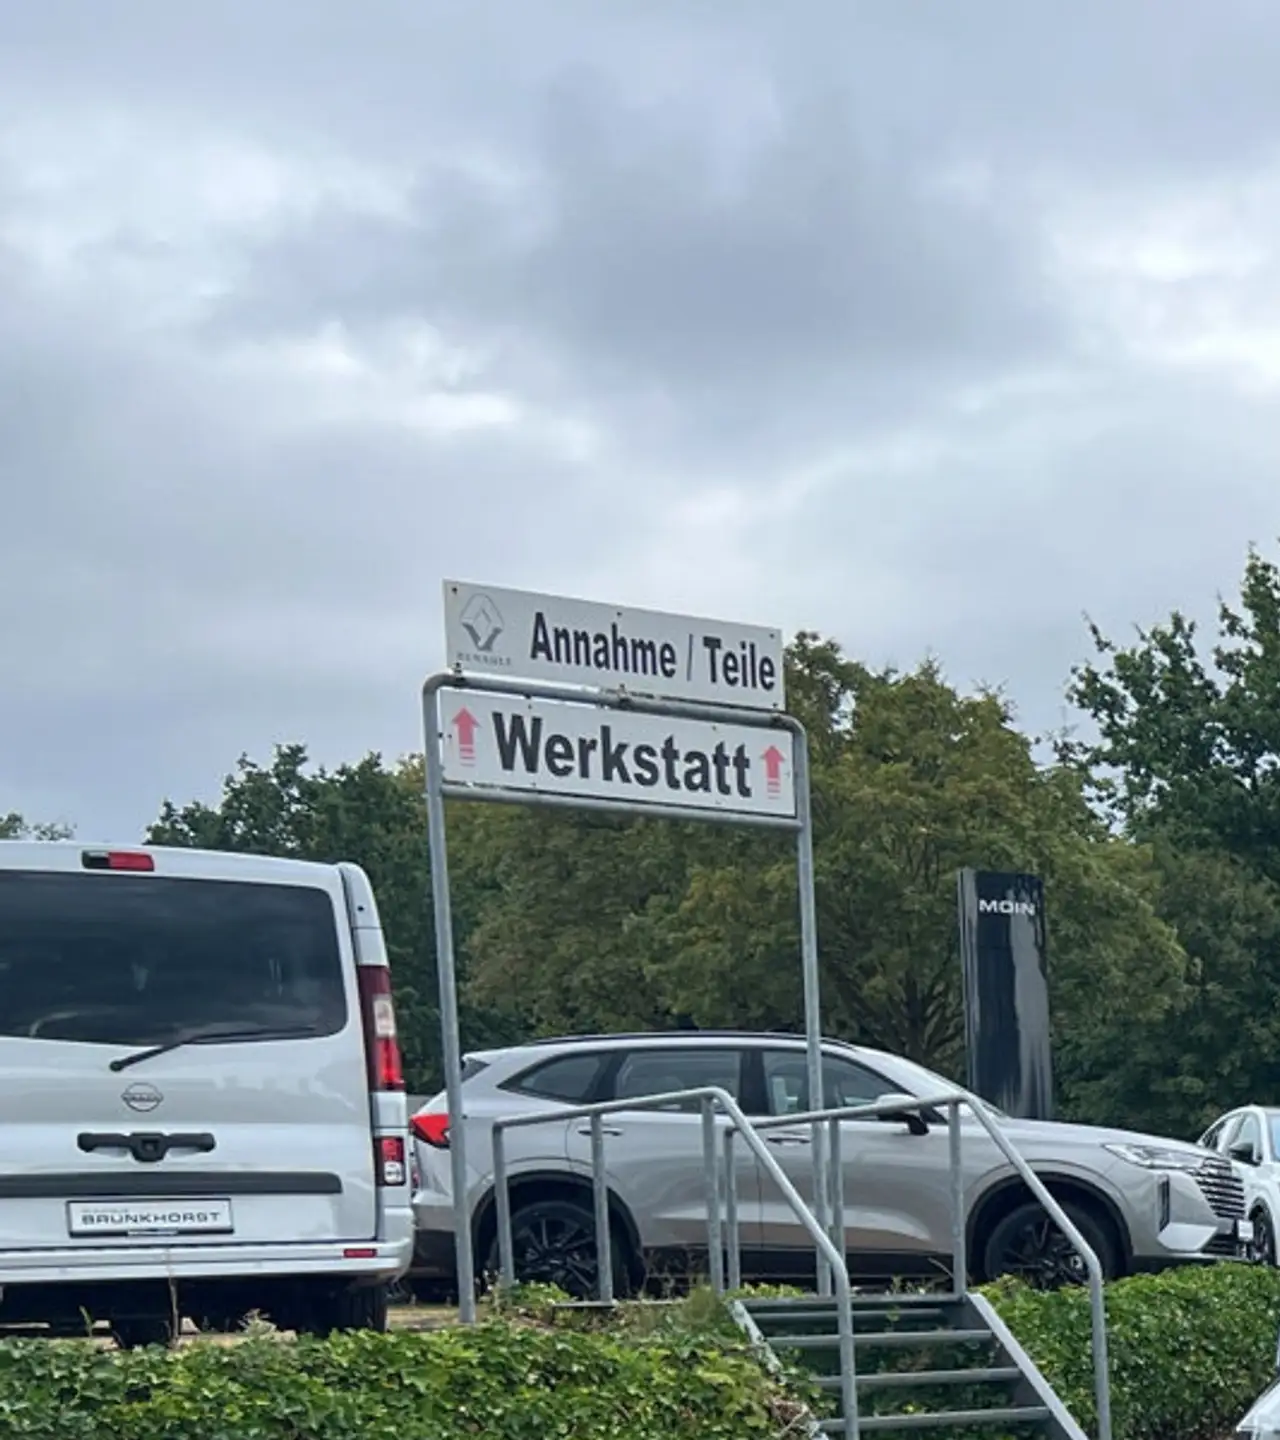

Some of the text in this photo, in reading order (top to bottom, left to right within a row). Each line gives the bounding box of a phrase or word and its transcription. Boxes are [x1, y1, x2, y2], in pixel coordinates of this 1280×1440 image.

[530, 612, 677, 679] Annahme
[703, 636, 776, 690] Teile
[492, 711, 752, 798] Werkstatt
[979, 899, 1036, 916] MOIN
[81, 1211, 221, 1225] BRUNKHORST
